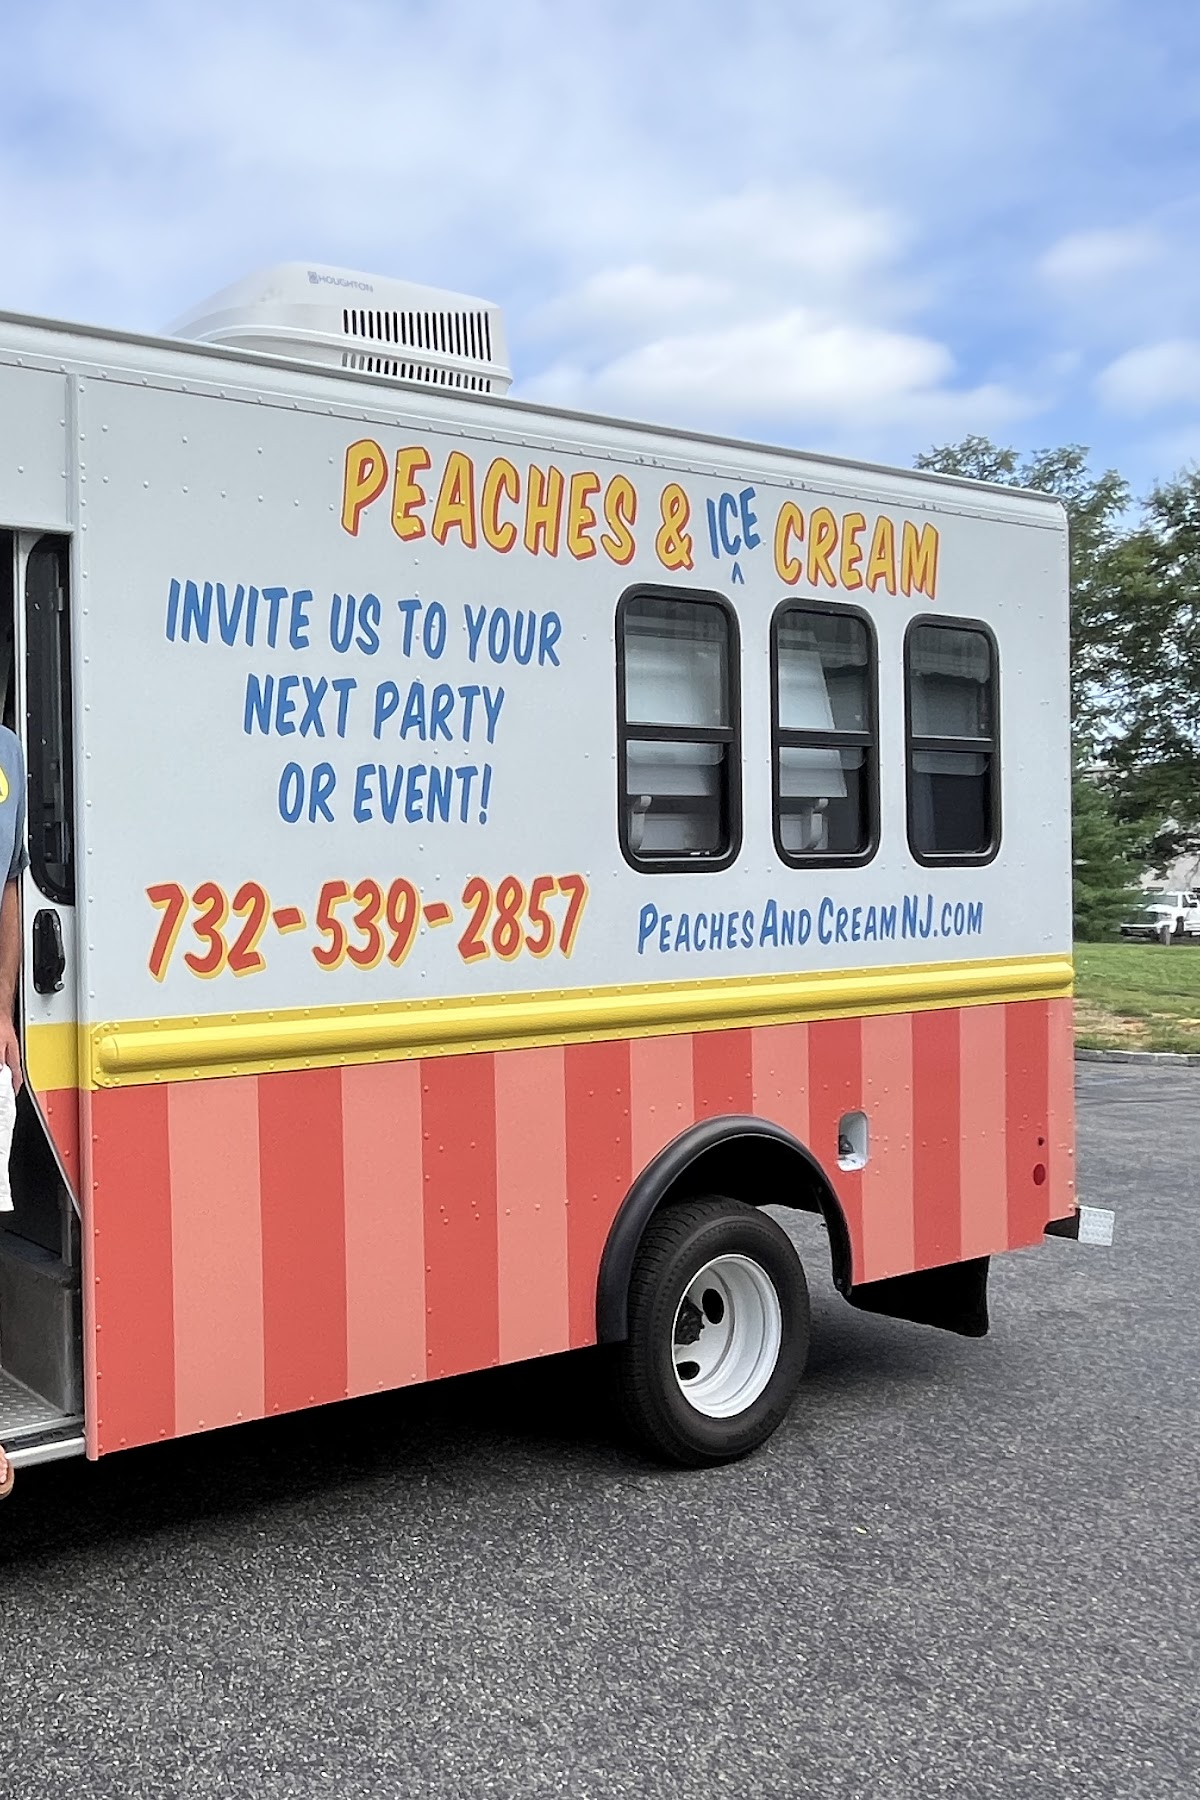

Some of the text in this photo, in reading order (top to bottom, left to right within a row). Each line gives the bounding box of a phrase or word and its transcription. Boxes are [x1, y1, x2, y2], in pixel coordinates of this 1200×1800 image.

[318, 275, 374, 292] HOUGHTON
[341, 438, 940, 599] PEACHES & ICE CREAM
[166, 578, 562, 667] INVITE US TO YOUR
[243, 673, 505, 744] NEXT PARTY
[278, 761, 492, 825] OR EVENT!
[145, 873, 589, 983] 732-539-2857
